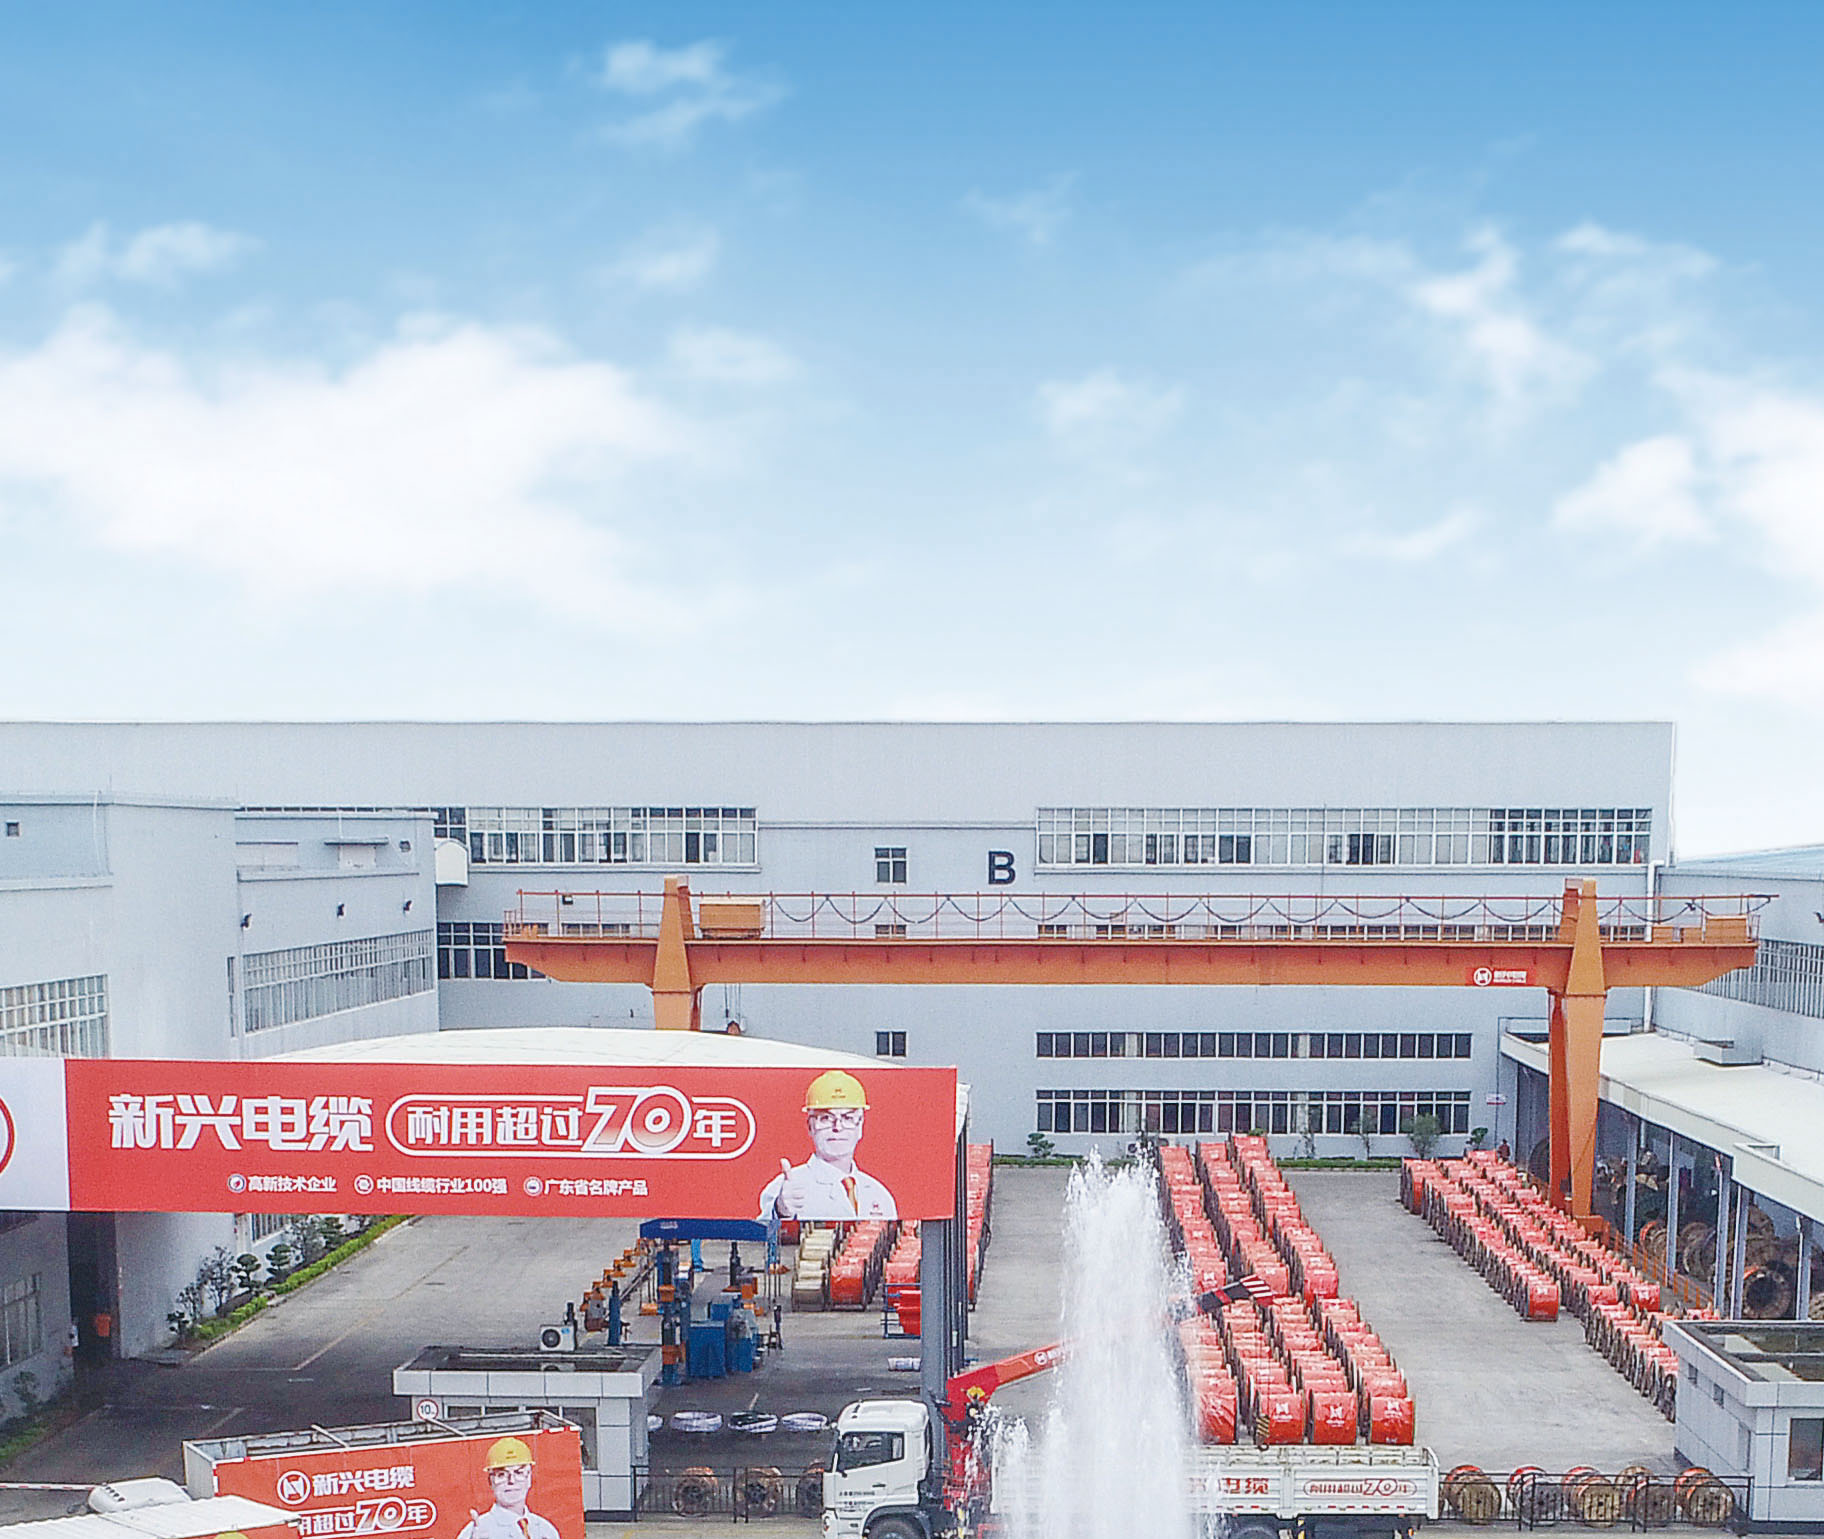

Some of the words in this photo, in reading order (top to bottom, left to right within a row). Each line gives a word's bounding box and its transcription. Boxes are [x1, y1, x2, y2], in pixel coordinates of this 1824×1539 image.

[987, 851, 1016, 885] B
[107, 1093, 374, 1152] 新兴电缆
[406, 1084, 738, 1155] 耐用超过70年
[247, 1175, 338, 1193] 高新技术企业
[376, 1176, 509, 1195] 中国线缆行业100强
[544, 1178, 649, 1197] 广东省名牌产品
[311, 1465, 416, 1498] 新兴电缆
[298, 1496, 430, 1536] 用超过70年
